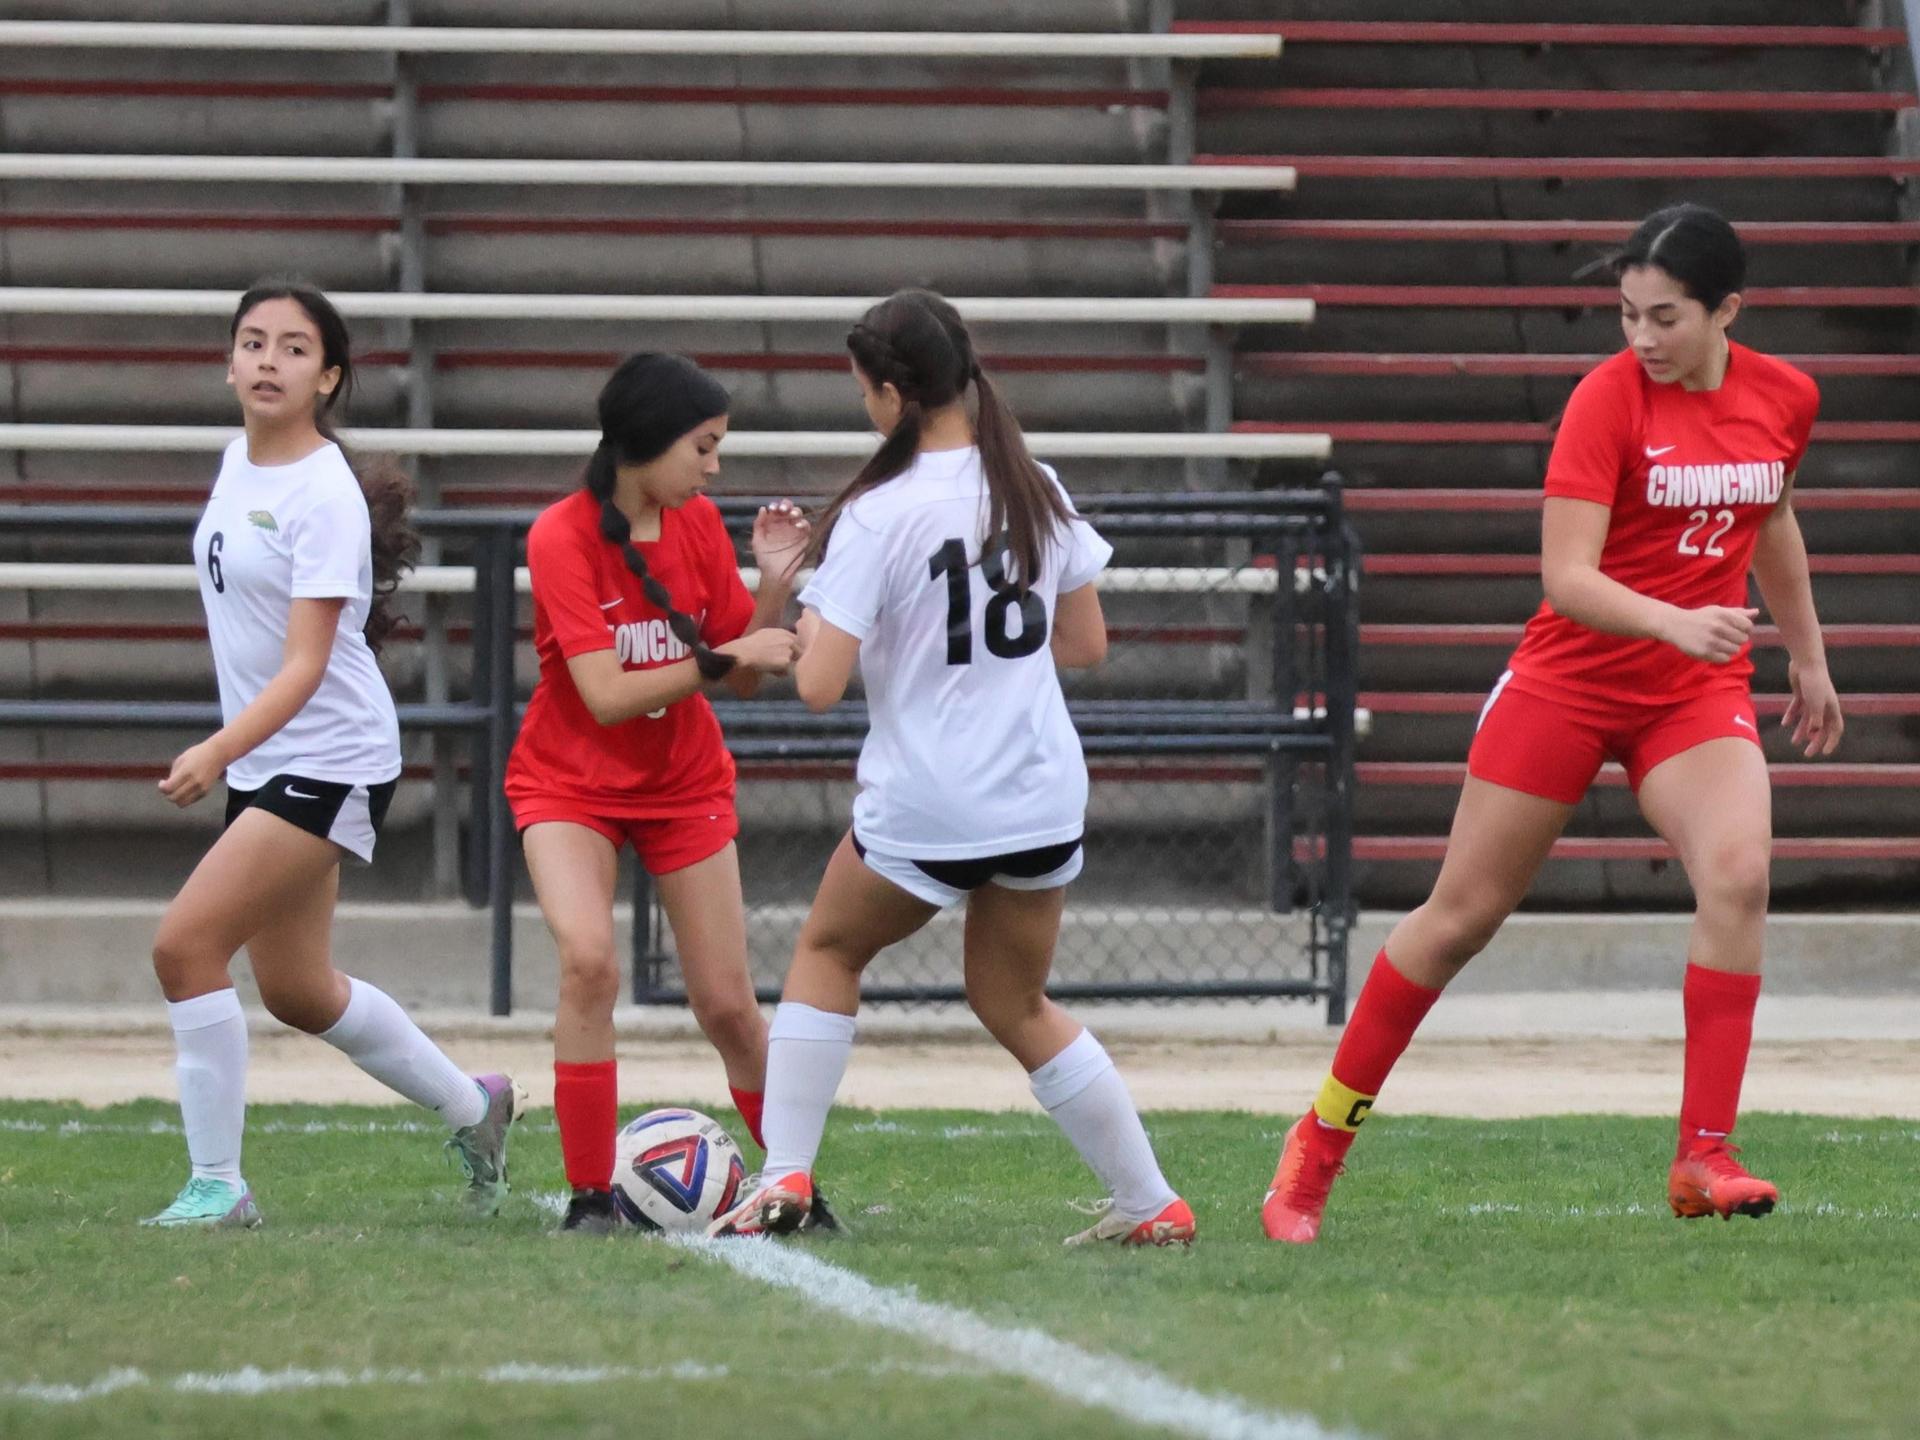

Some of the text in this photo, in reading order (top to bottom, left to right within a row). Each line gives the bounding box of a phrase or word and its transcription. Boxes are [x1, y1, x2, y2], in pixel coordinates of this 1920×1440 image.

[1677, 509, 1735, 557] 22
[208, 531, 225, 594] 6
[928, 531, 1048, 665] 18
[1346, 1099, 1373, 1127] C
